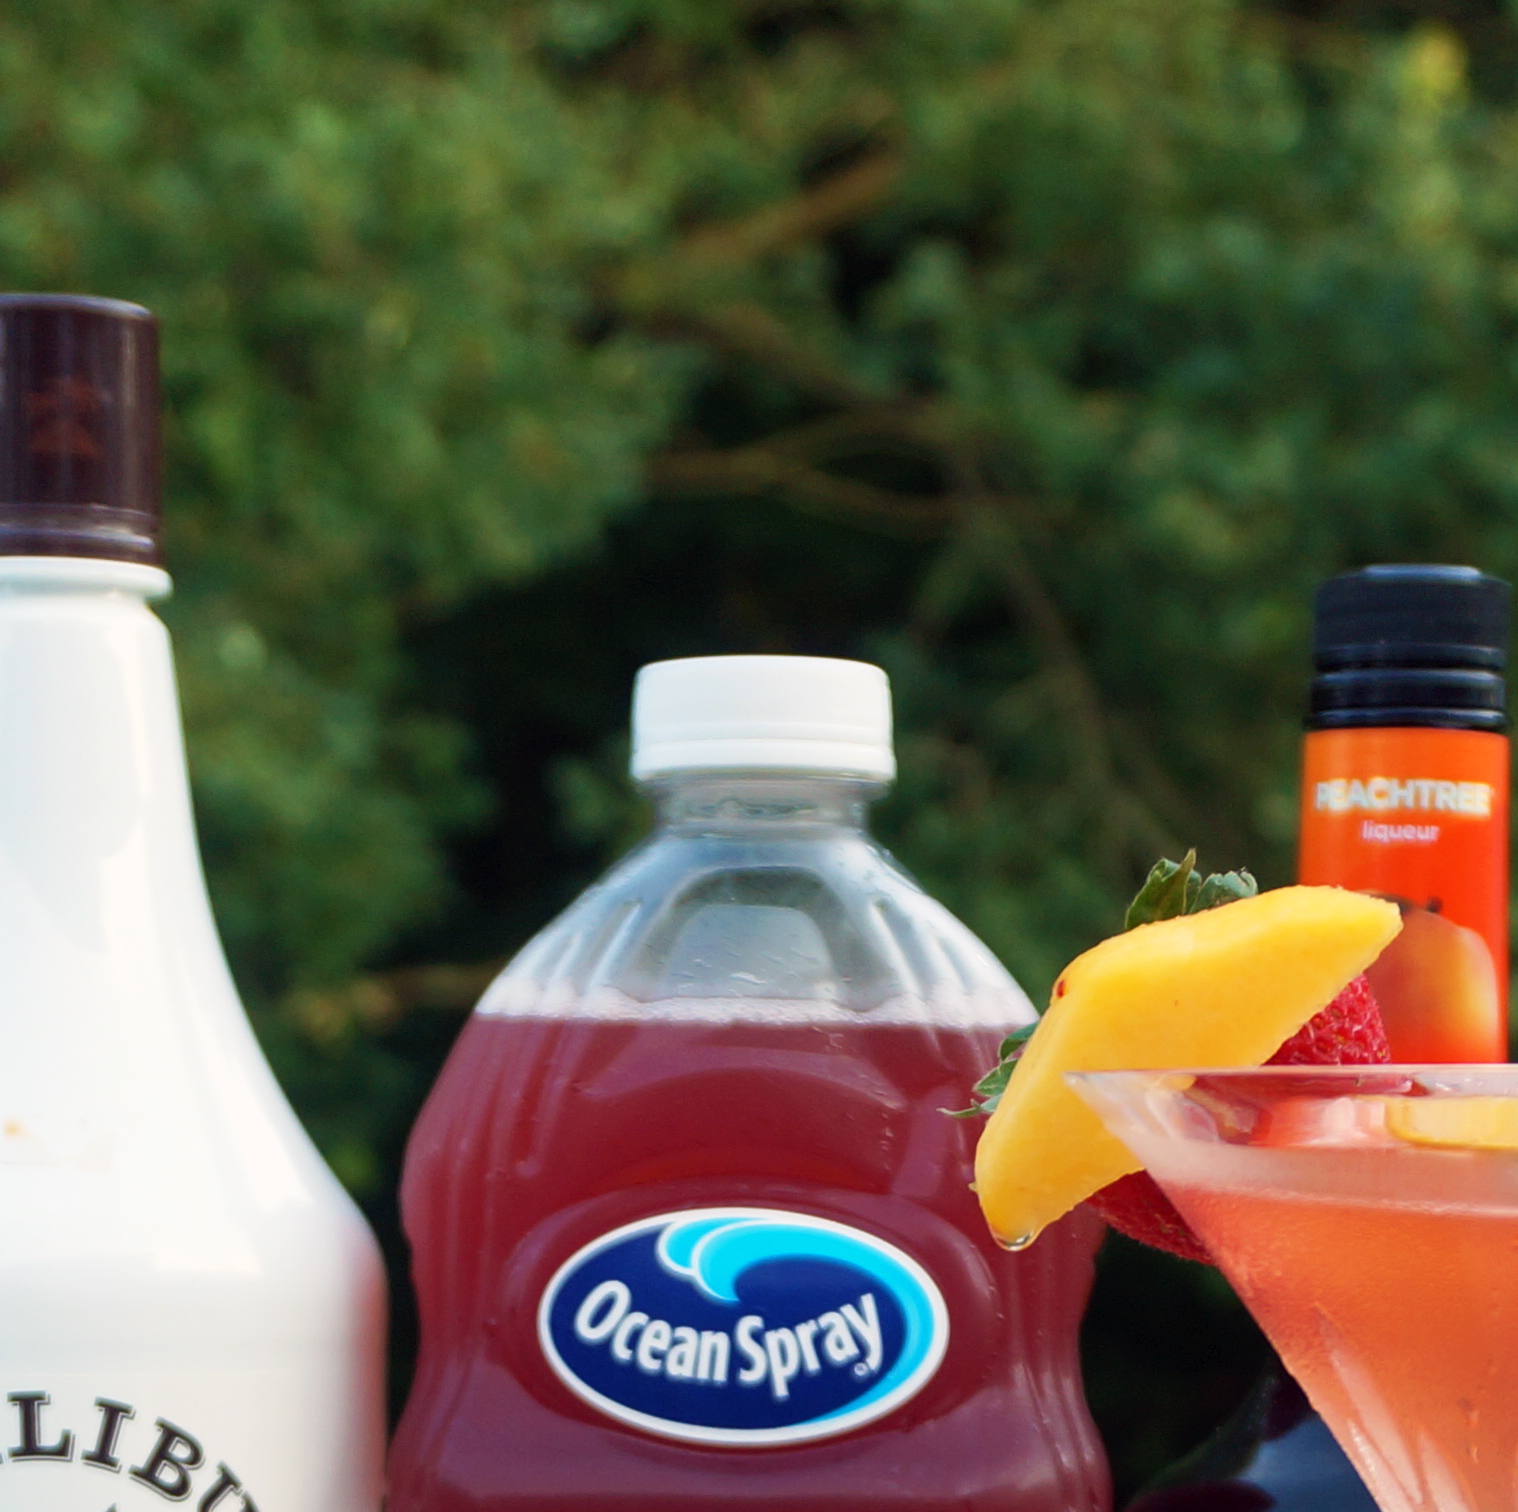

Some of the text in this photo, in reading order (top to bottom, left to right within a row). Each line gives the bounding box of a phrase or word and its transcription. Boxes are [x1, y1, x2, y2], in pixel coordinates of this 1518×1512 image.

[1316, 777, 1491, 818] PEACHTREE
[1361, 820, 1441, 843] liqueur
[574, 1279, 883, 1399] Ocean Spray
